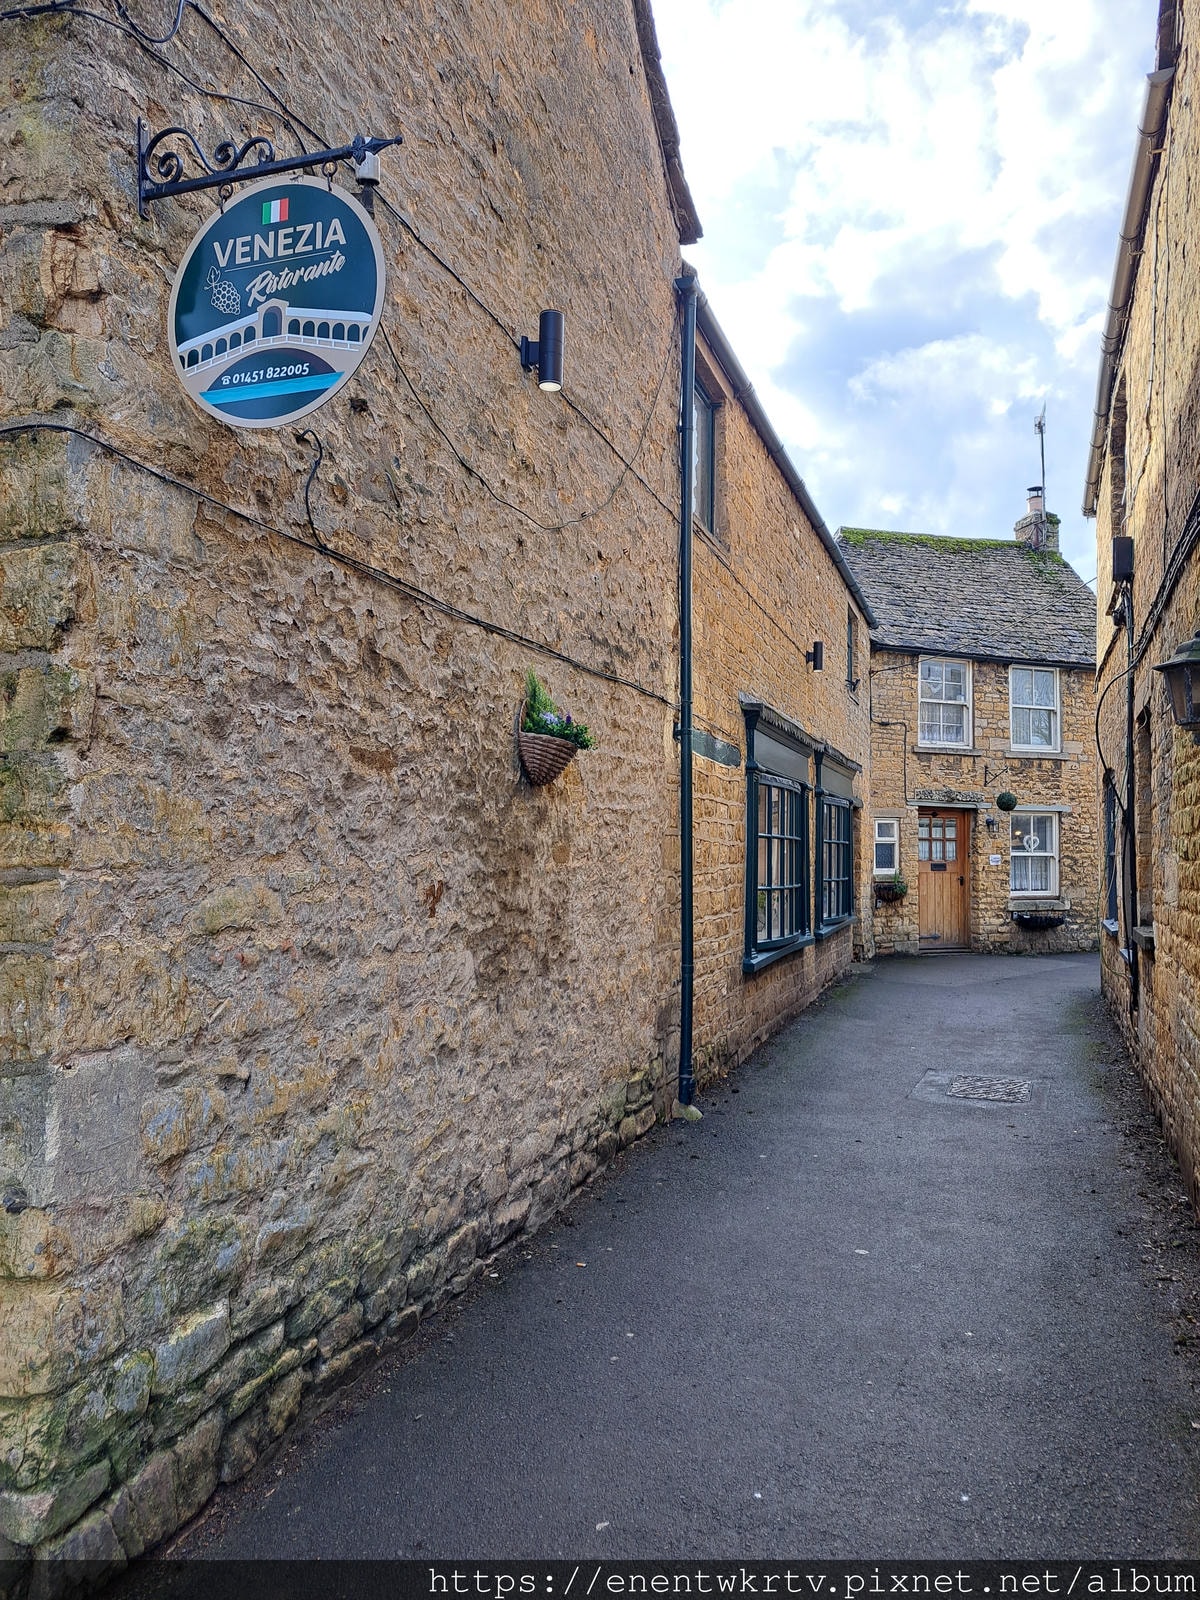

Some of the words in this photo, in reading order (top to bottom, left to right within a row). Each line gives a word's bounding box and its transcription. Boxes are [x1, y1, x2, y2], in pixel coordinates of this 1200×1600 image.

[213, 218, 347, 268] VENEZIA
[245, 250, 346, 307] Ristorante
[232, 369, 264, 384] 01451
[266, 362, 310, 379] 822005
